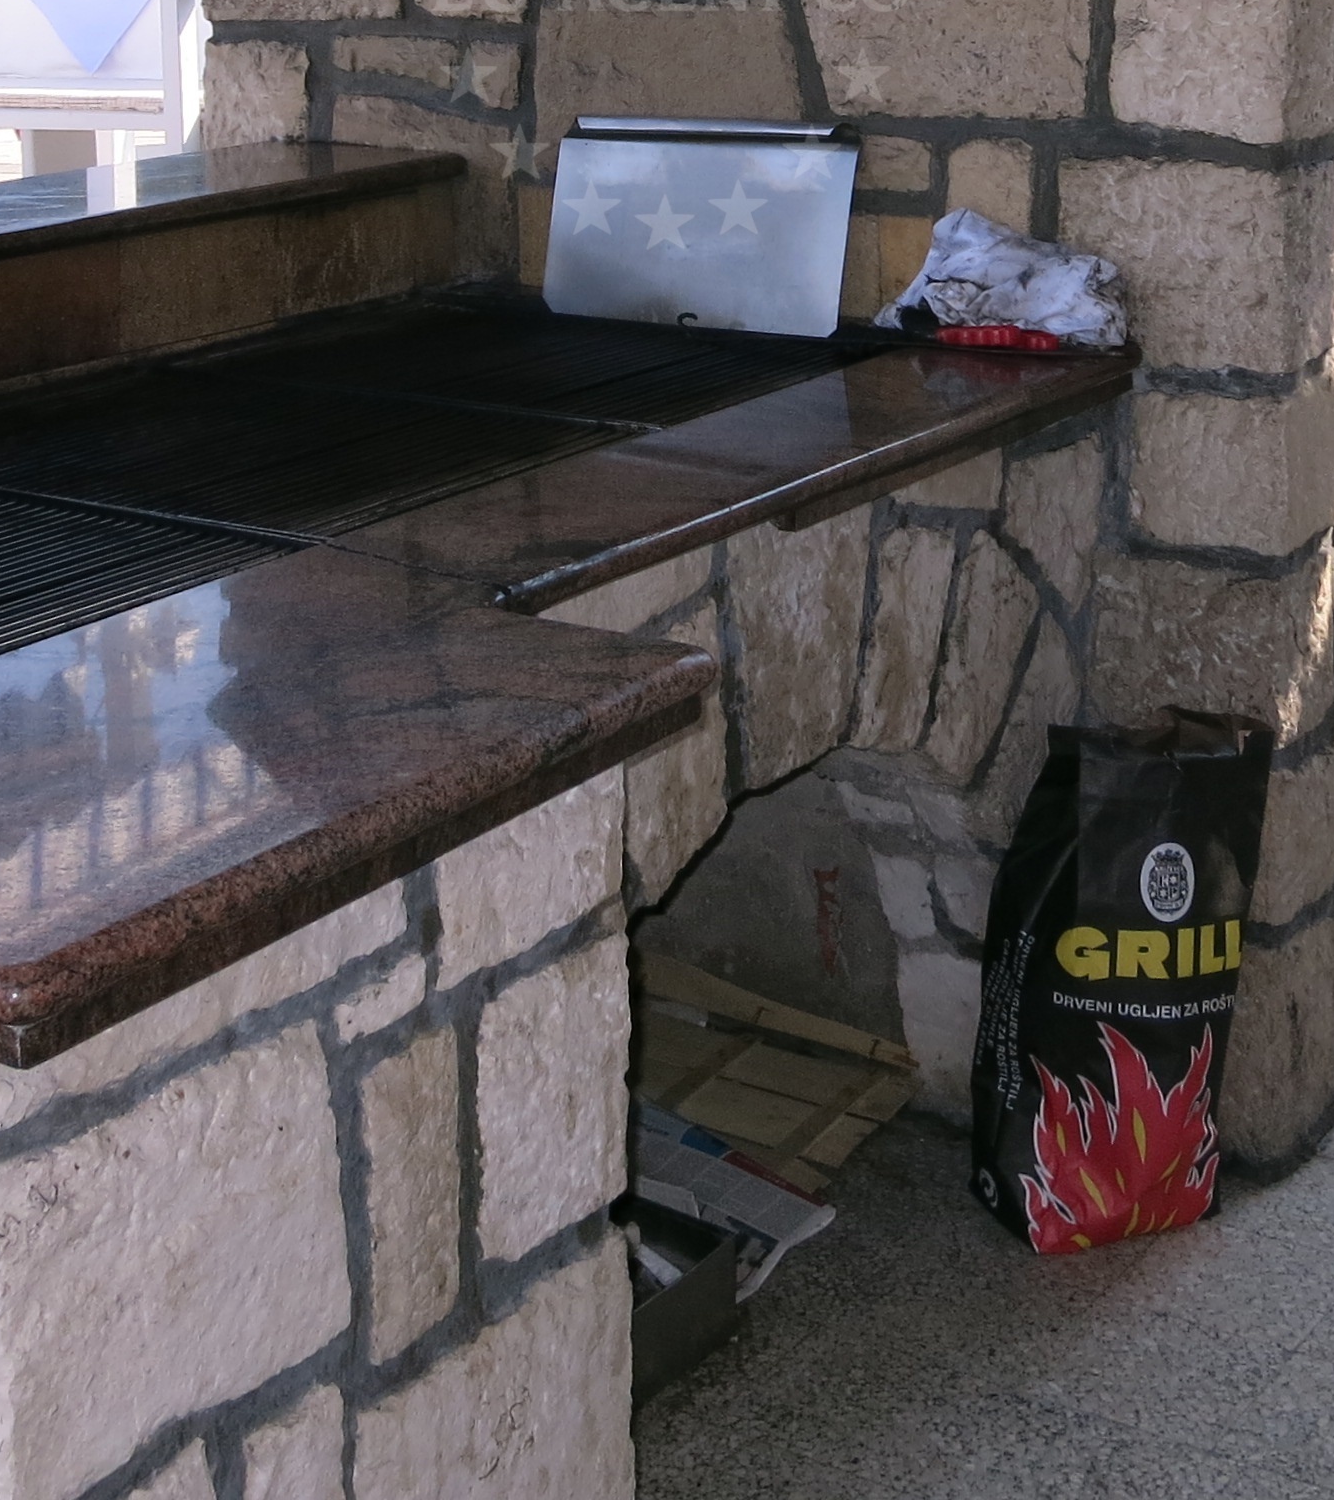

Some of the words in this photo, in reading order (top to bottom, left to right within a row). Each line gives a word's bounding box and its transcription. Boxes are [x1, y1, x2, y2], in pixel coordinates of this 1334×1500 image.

[1018, 935, 1035, 985] DRVENI
[1055, 919, 1242, 981] GRILL
[1008, 987, 1022, 1038] UGLJEN
[1053, 991, 1112, 1014] DRVENI
[1118, 1003, 1182, 1019] UGLJEN
[1184, 1004, 1199, 1016] ZA
[997, 1024, 1008, 1040] ZA
[1008, 1041, 1018, 1055] ZA
[997, 1044, 1010, 1092] ROŠTILJ
[1005, 1058, 1024, 1110] ROŠTILJ
